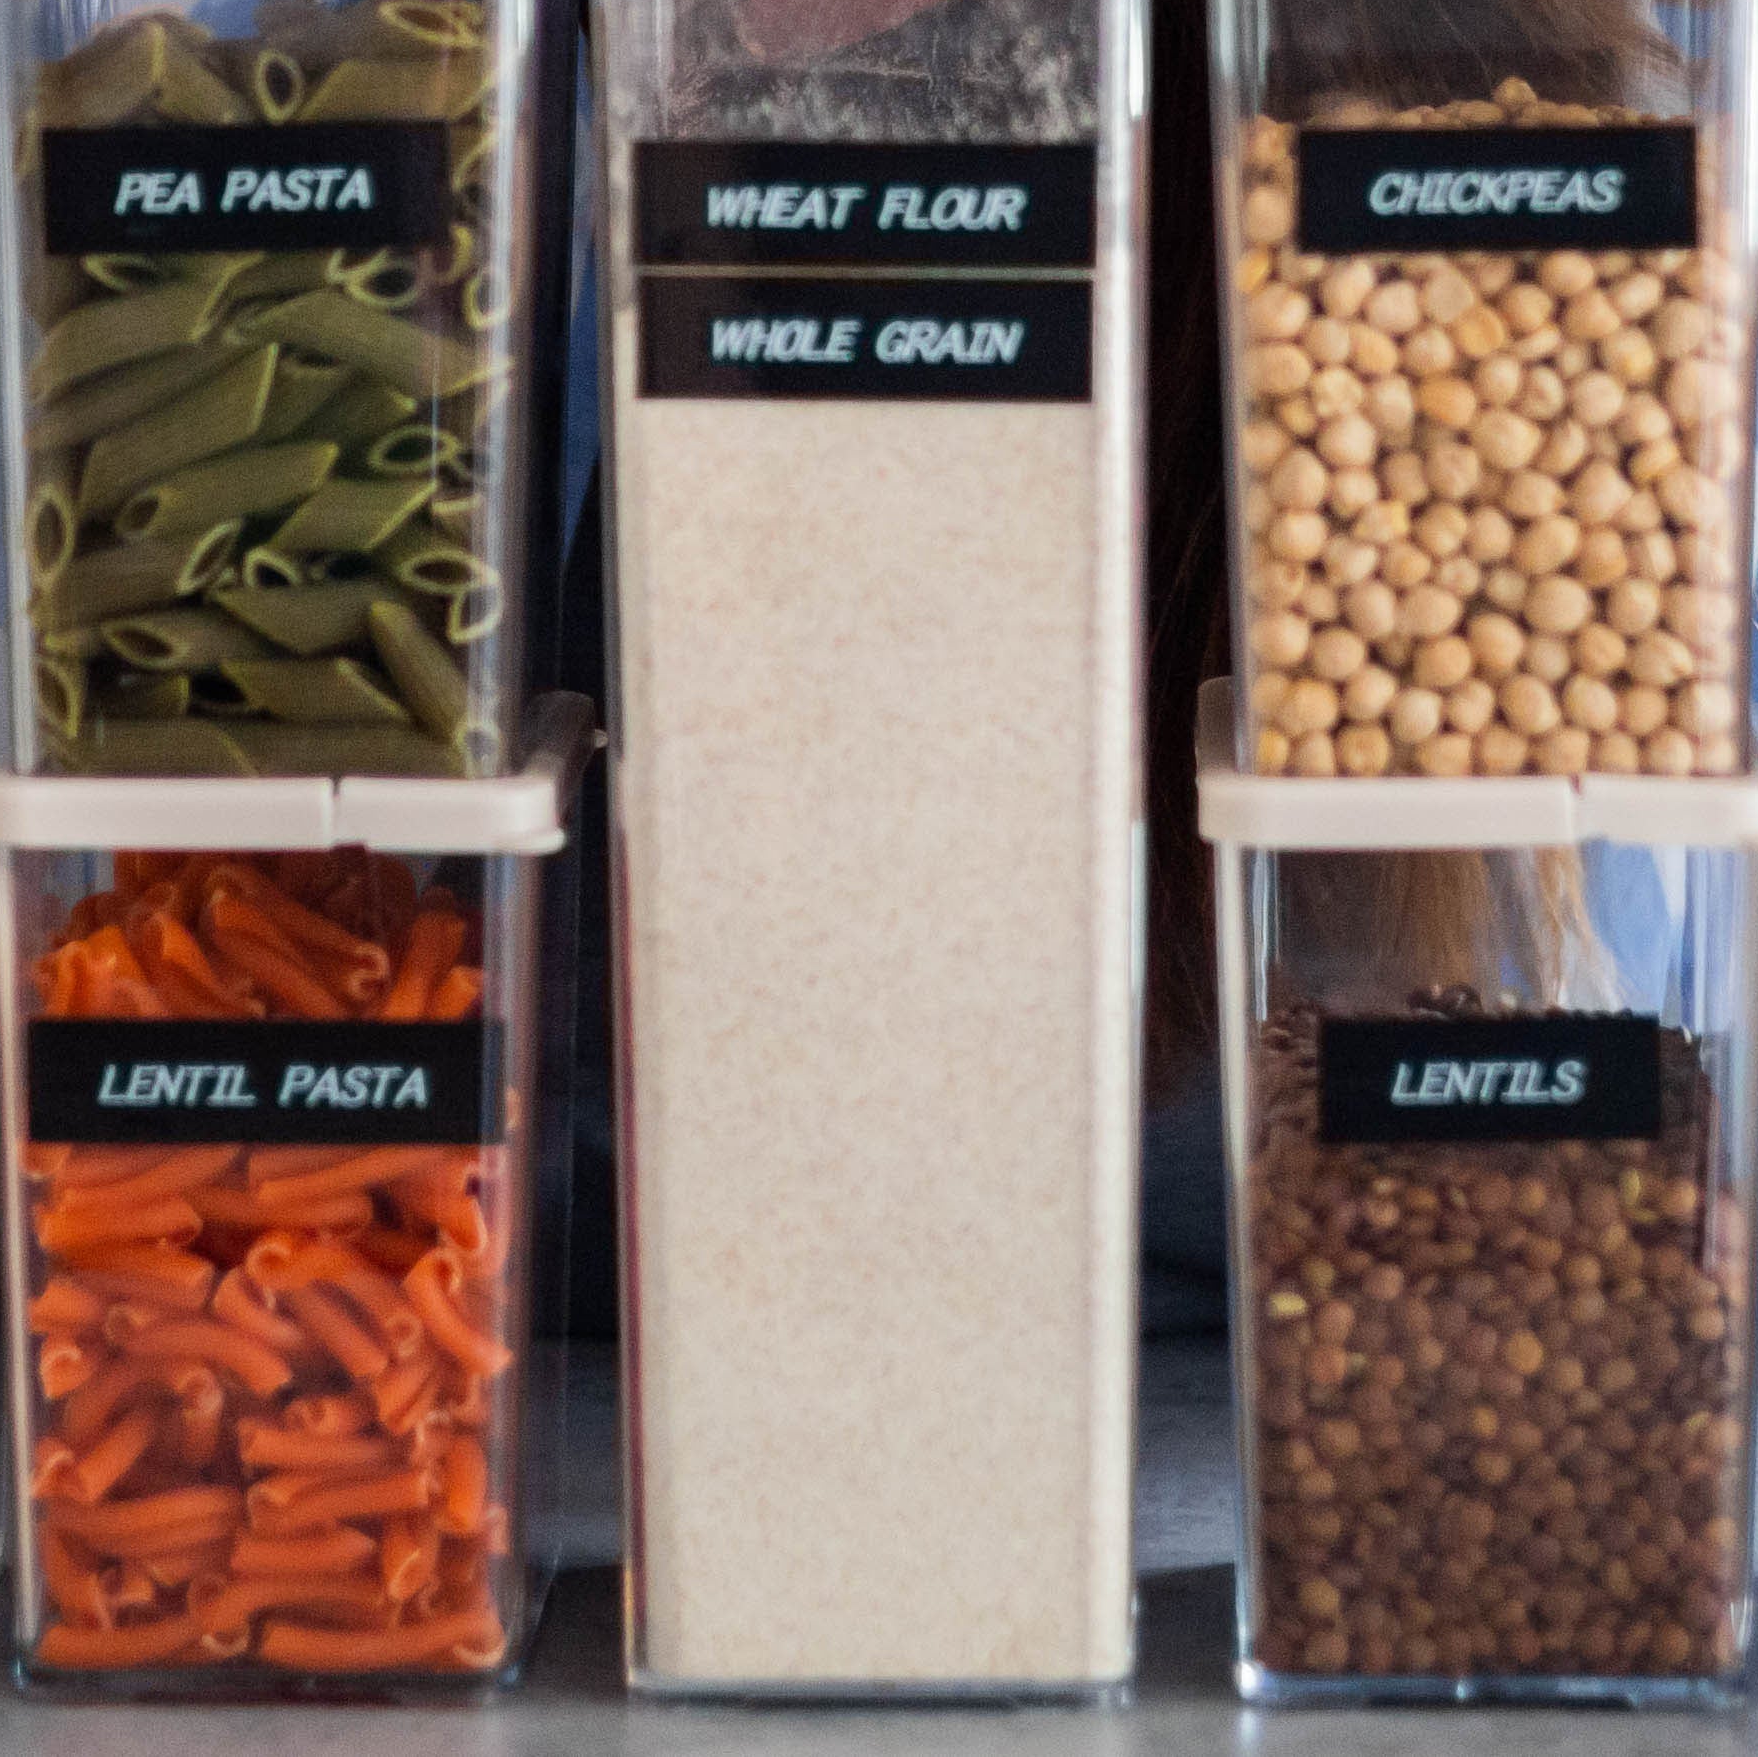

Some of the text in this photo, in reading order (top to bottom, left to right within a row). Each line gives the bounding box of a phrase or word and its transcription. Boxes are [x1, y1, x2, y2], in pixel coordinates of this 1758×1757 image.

[114, 166, 373, 215] PEA PASTA
[706, 184, 1027, 231] WHEAT FLOUR
[1367, 168, 1625, 216] CHICKPEAS
[711, 318, 1025, 365] WHOLE GRAIN
[97, 1062, 430, 1108] LENTIL PASTA
[1389, 1059, 1586, 1106] LENTILS
